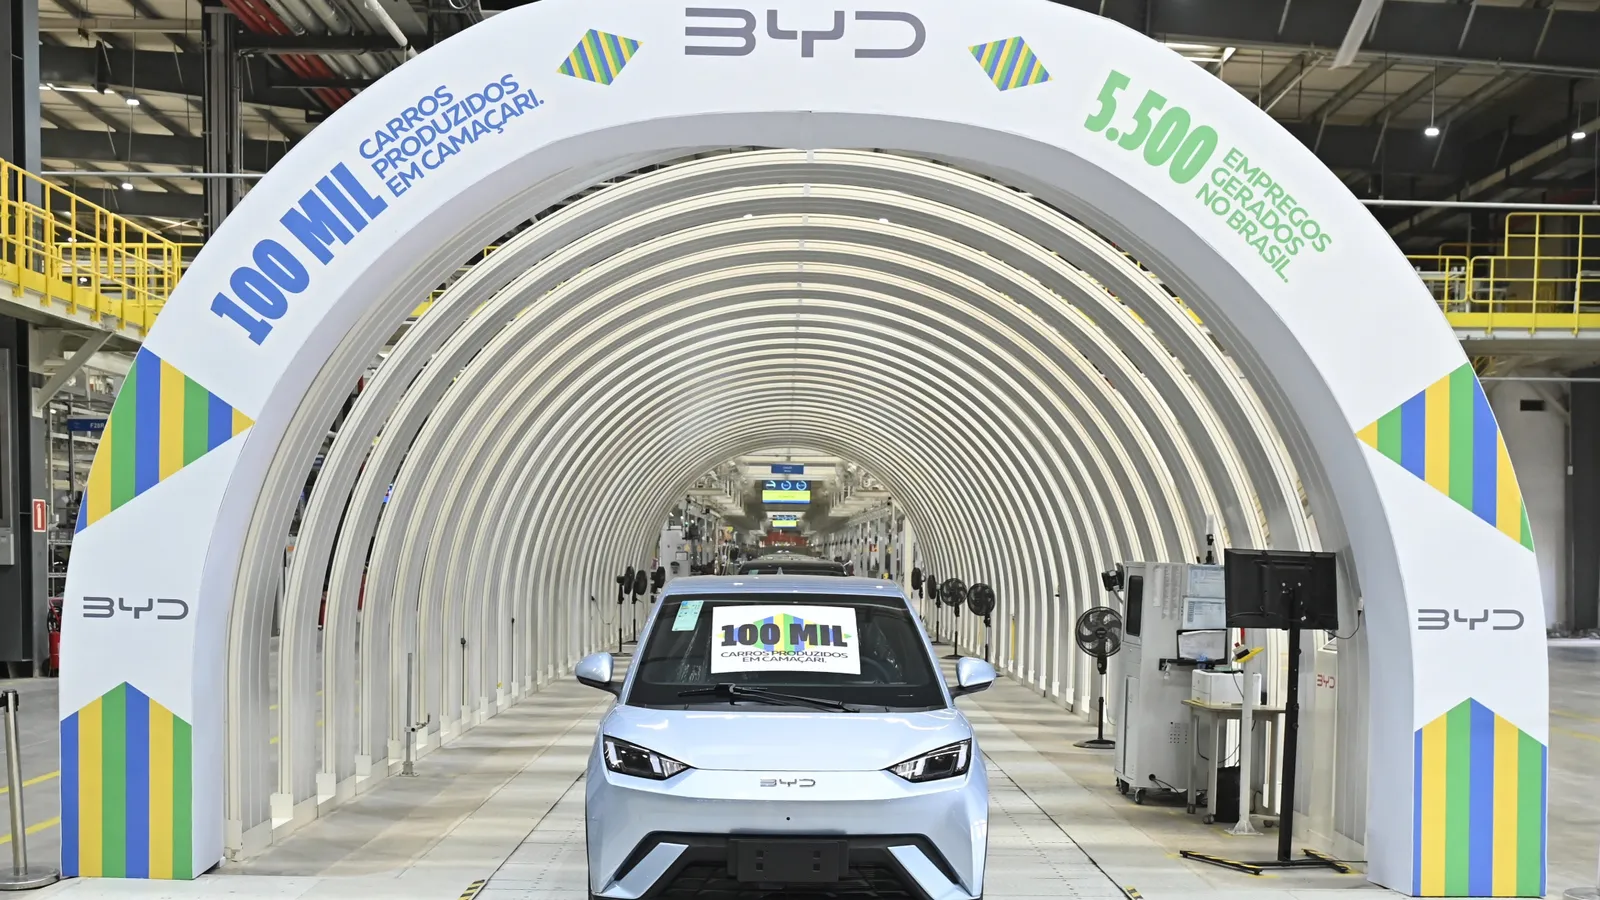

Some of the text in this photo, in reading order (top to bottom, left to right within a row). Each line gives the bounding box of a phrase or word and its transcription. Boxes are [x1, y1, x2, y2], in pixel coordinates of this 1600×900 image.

[684, 7, 926, 58] BYD
[360, 85, 454, 160] CARROS
[371, 73, 520, 180] PRODUZIDOS
[386, 89, 545, 198] EM CAMAÇARI.
[1084, 70, 1219, 185] 5.500
[1210, 166, 1305, 257] GERADOS
[1223, 147, 1332, 253] EMPREGOS
[210, 162, 389, 345] 100 MIL
[1195, 183, 1290, 284] NO BRASIL.
[82, 596, 189, 621] BYD
[721, 623, 848, 648] 100 MIL
[1417, 608, 1525, 631] BYD
[720, 650, 849, 659] CARROS PRODUZIDOS
[762, 656, 827, 664] CAMAÇARI.
[1317, 674, 1336, 688] BYD
[761, 778, 816, 787] BYD
